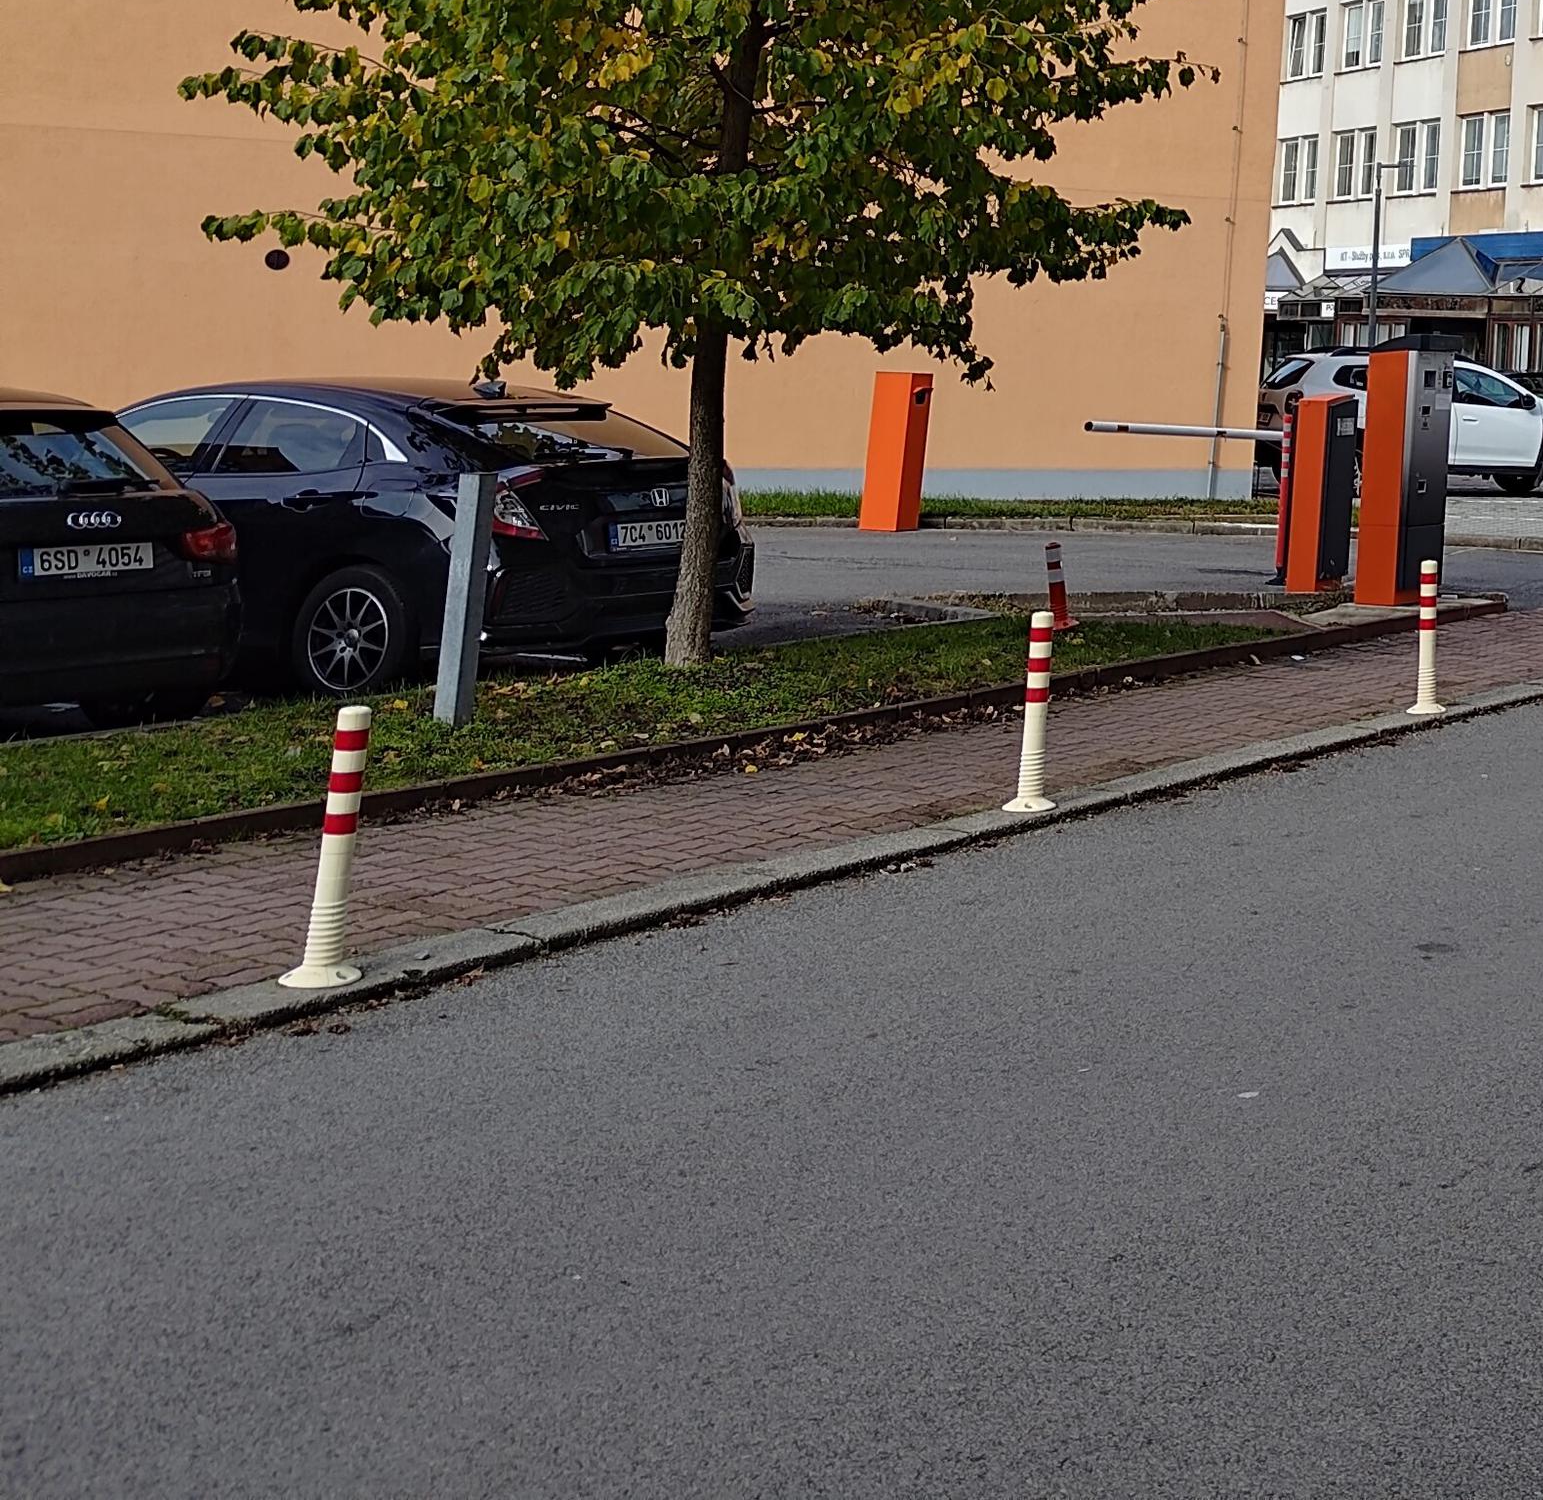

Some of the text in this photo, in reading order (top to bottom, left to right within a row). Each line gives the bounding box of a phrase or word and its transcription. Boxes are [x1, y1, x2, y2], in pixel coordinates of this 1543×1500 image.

[540, 503, 580, 511] CIVIC
[620, 523, 646, 544] 7C4
[40, 545, 144, 572] 6SD 4054
